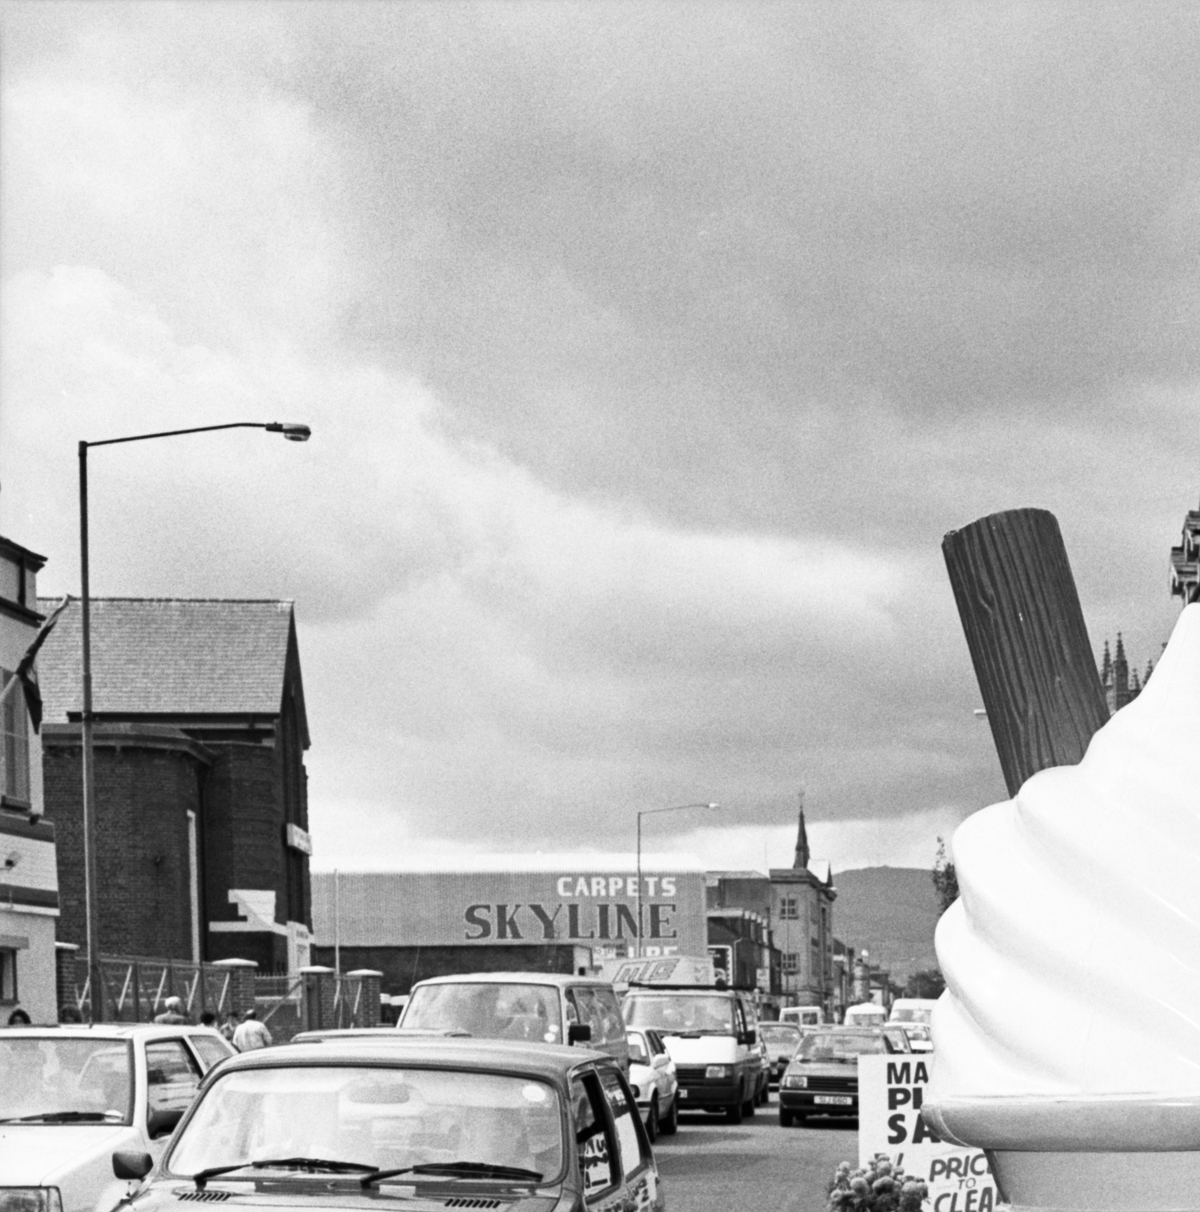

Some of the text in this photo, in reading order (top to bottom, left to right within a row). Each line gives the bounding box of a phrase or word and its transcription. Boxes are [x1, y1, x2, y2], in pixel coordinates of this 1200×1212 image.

[557, 876, 678, 898] CARPETS
[464, 903, 678, 941] SKYLINE
[886, 1061, 929, 1085] MA
[887, 1113, 942, 1144] SA
[958, 1177, 977, 1190] TO
